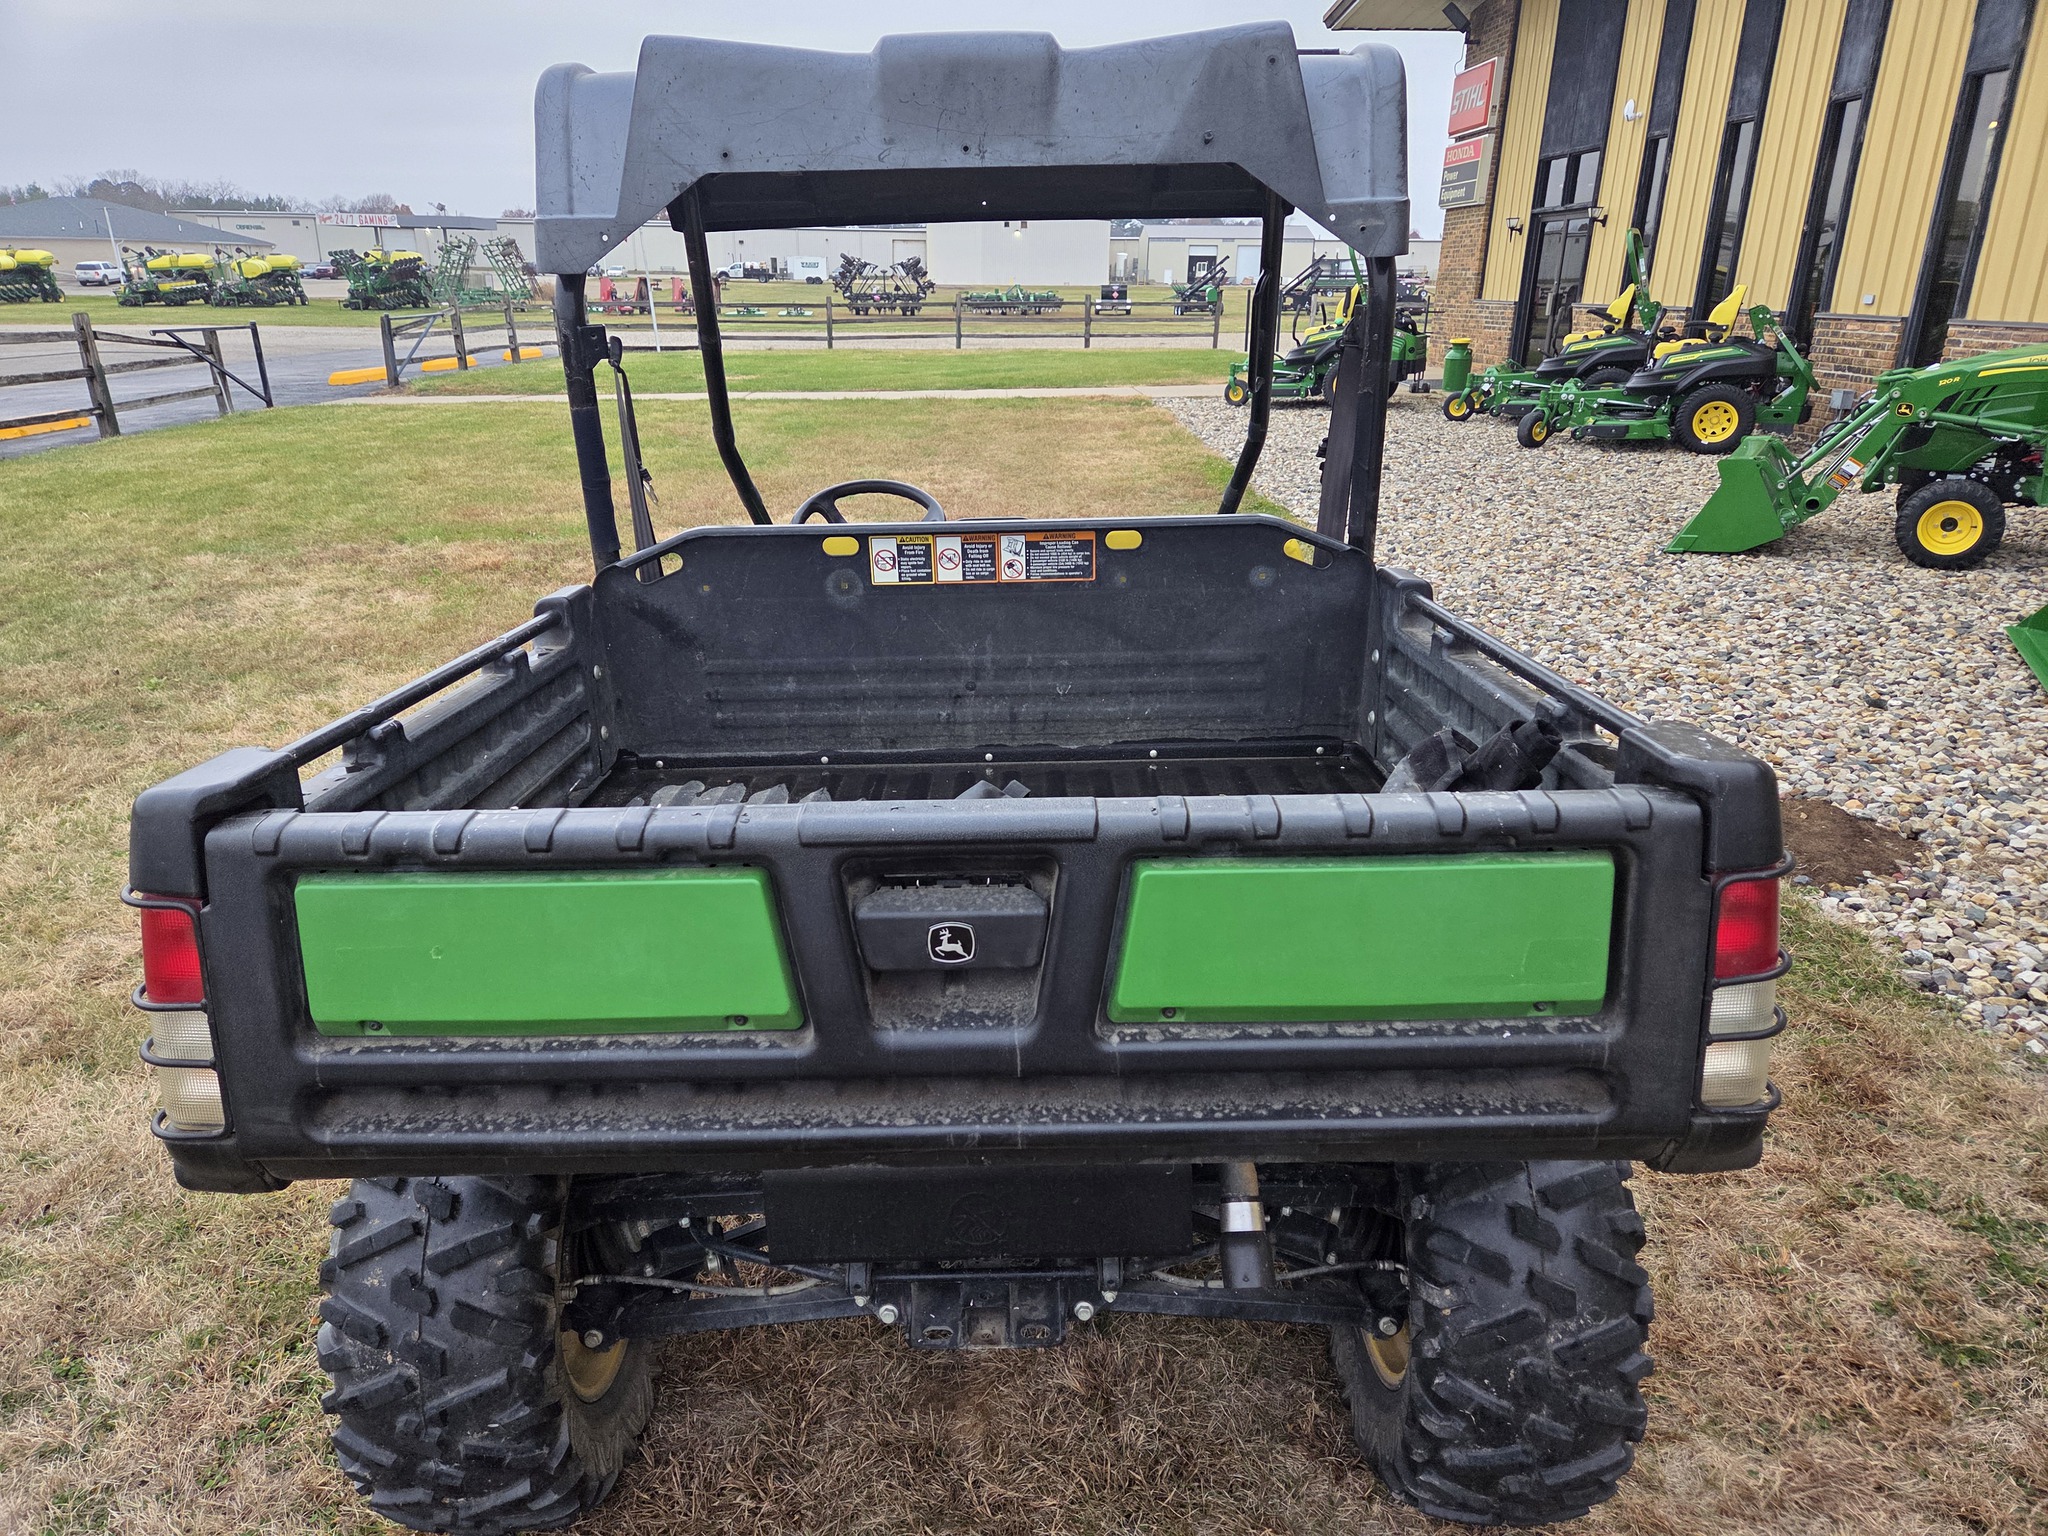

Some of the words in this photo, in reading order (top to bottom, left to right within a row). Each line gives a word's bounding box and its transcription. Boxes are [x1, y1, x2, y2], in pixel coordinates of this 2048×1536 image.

[1451, 82, 1485, 116] STIHL
[1446, 145, 1475, 163] HONDA
[1443, 171, 1459, 183] Power
[1441, 186, 1466, 202] Equipment
[335, 214, 354, 224] 24/7
[358, 214, 388, 225] GAMING
